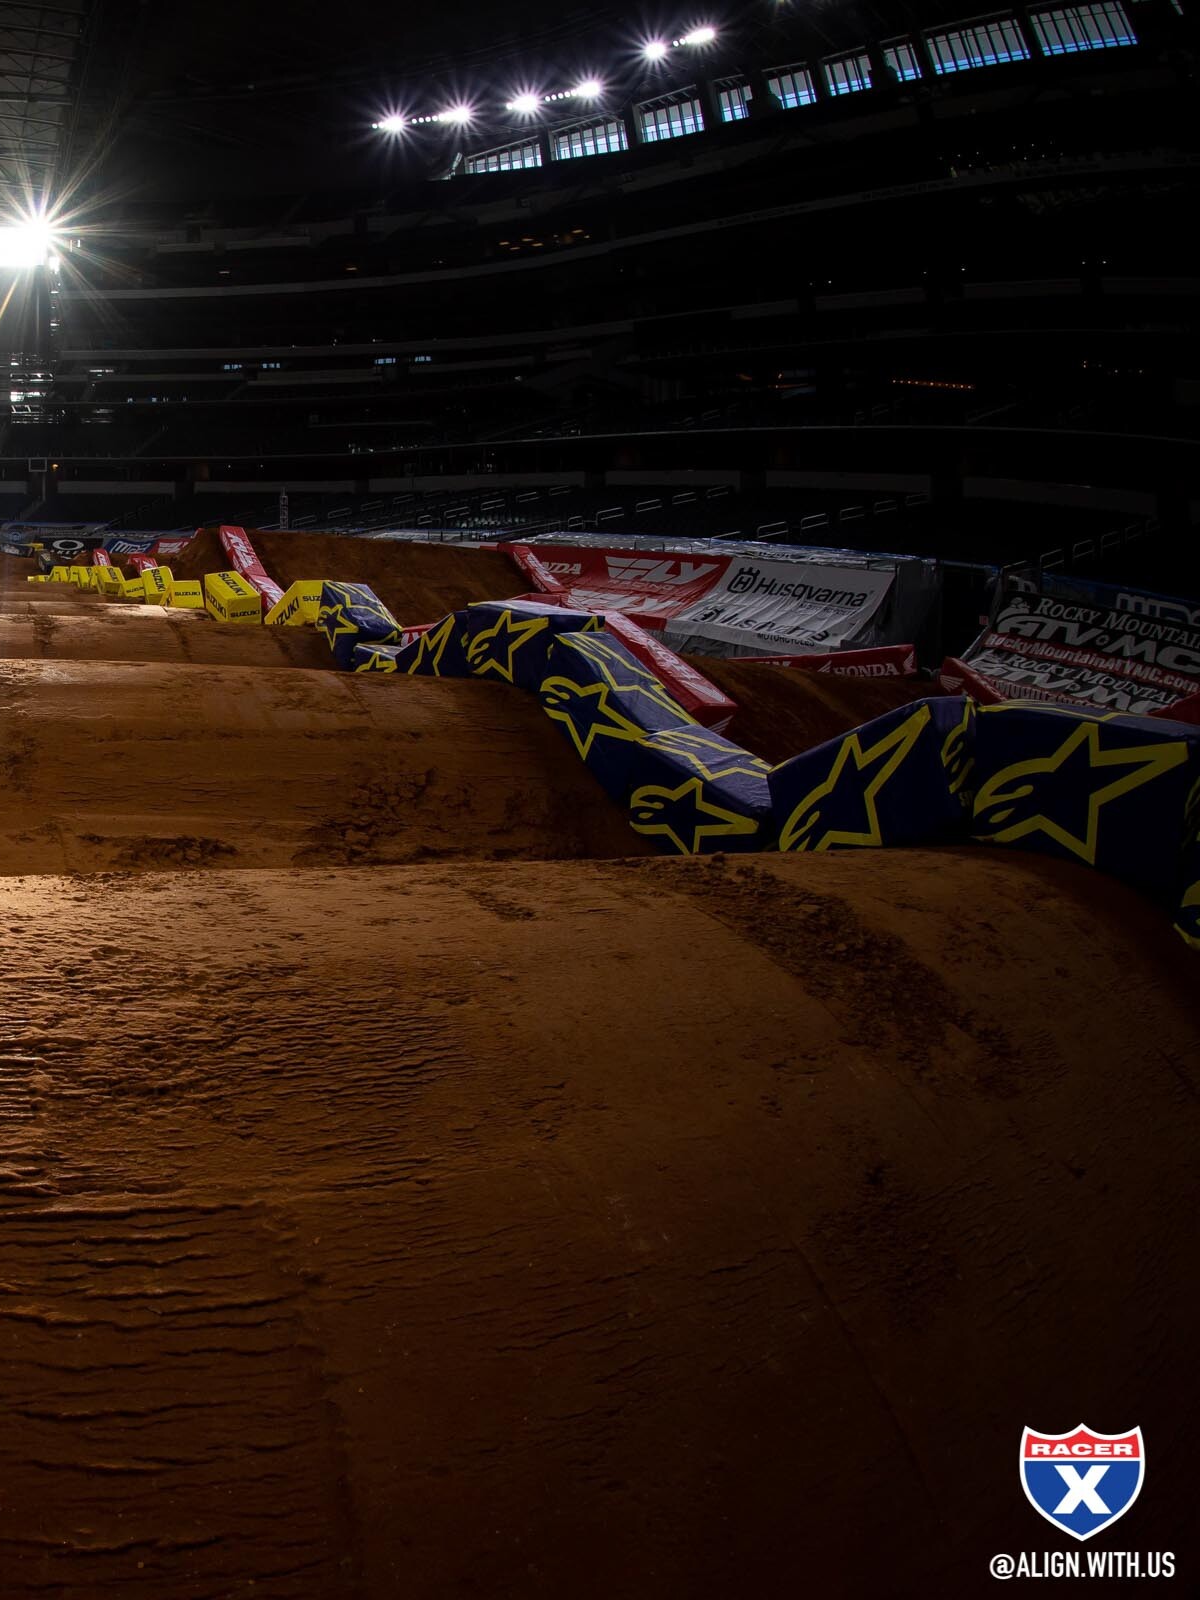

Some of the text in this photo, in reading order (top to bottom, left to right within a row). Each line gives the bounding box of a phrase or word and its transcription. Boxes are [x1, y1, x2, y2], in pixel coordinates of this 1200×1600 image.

[218, 572, 249, 596] SUZUKI
[752, 577, 868, 608] Husqvarna
[1033, 597, 1102, 625] ROCKY
